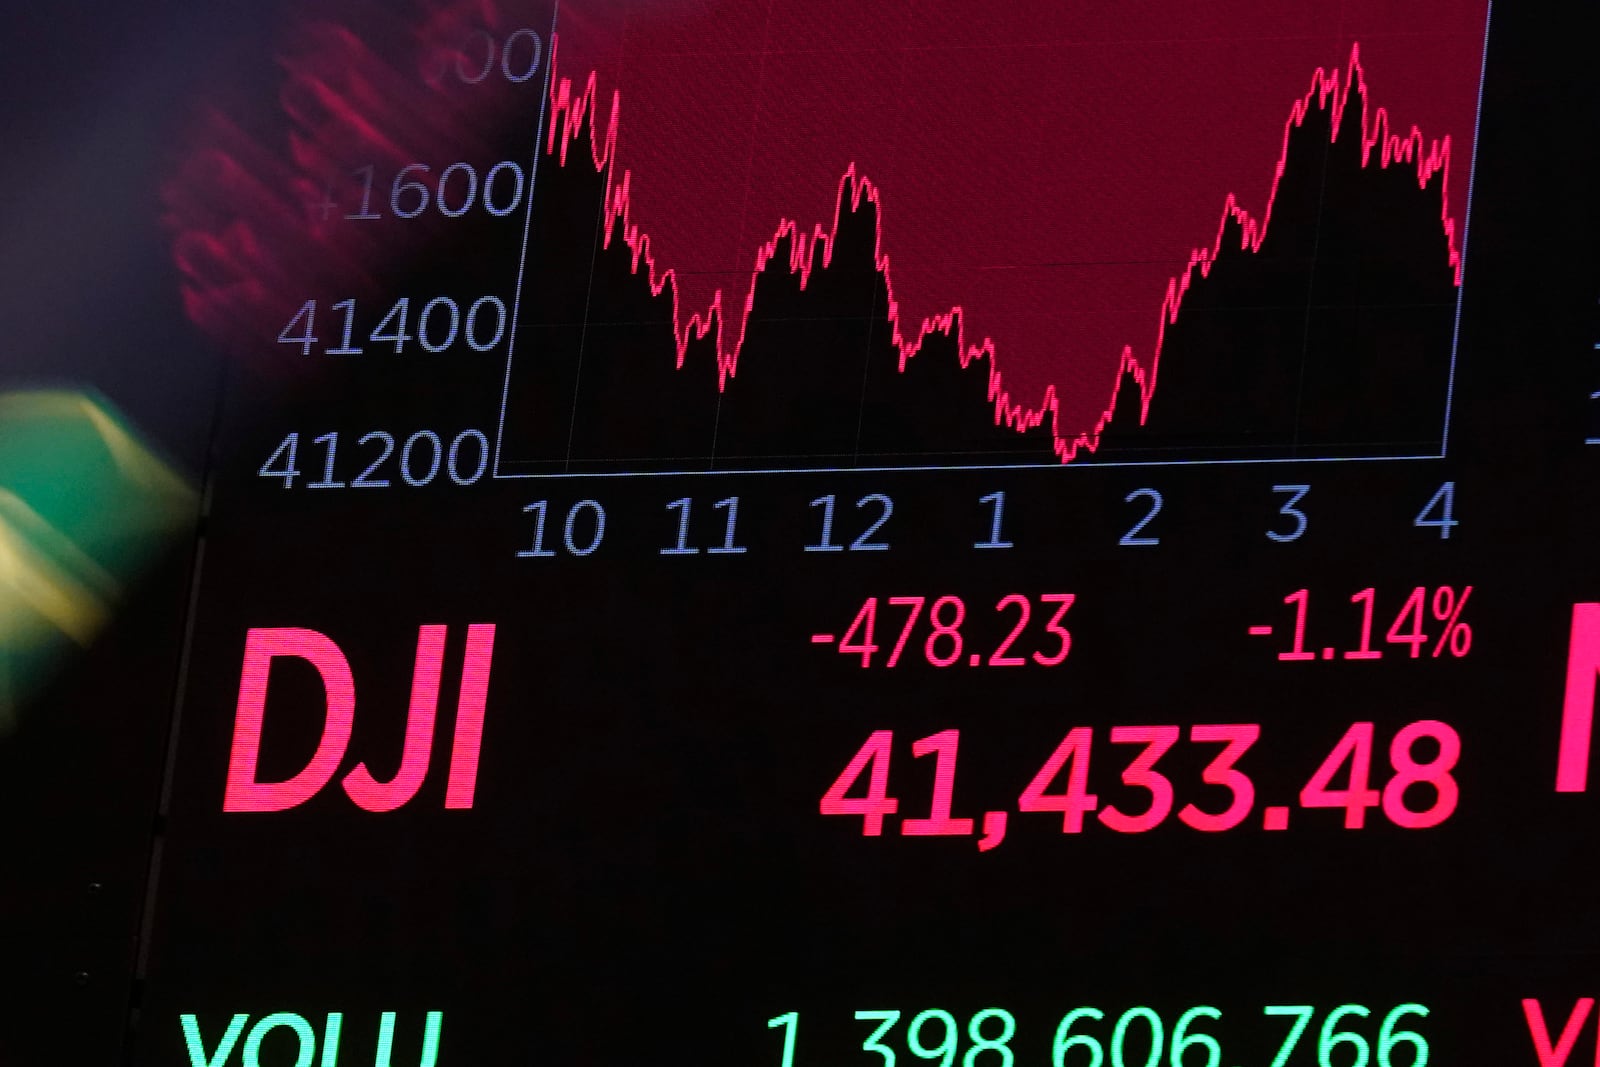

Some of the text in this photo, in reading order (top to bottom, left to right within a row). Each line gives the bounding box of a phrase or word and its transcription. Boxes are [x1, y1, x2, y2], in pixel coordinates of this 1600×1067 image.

[277, 296, 507, 356] 41400
[259, 429, 491, 489] 41200
[517, 481, 1458, 558] 10 11 12 1 2 3 4
[810, 585, 1474, 669] -478.23 -1.14%
[222, 623, 497, 813] DJI
[819, 719, 1462, 852] 41,433.48
[1521, 997, 1600, 1067] V
